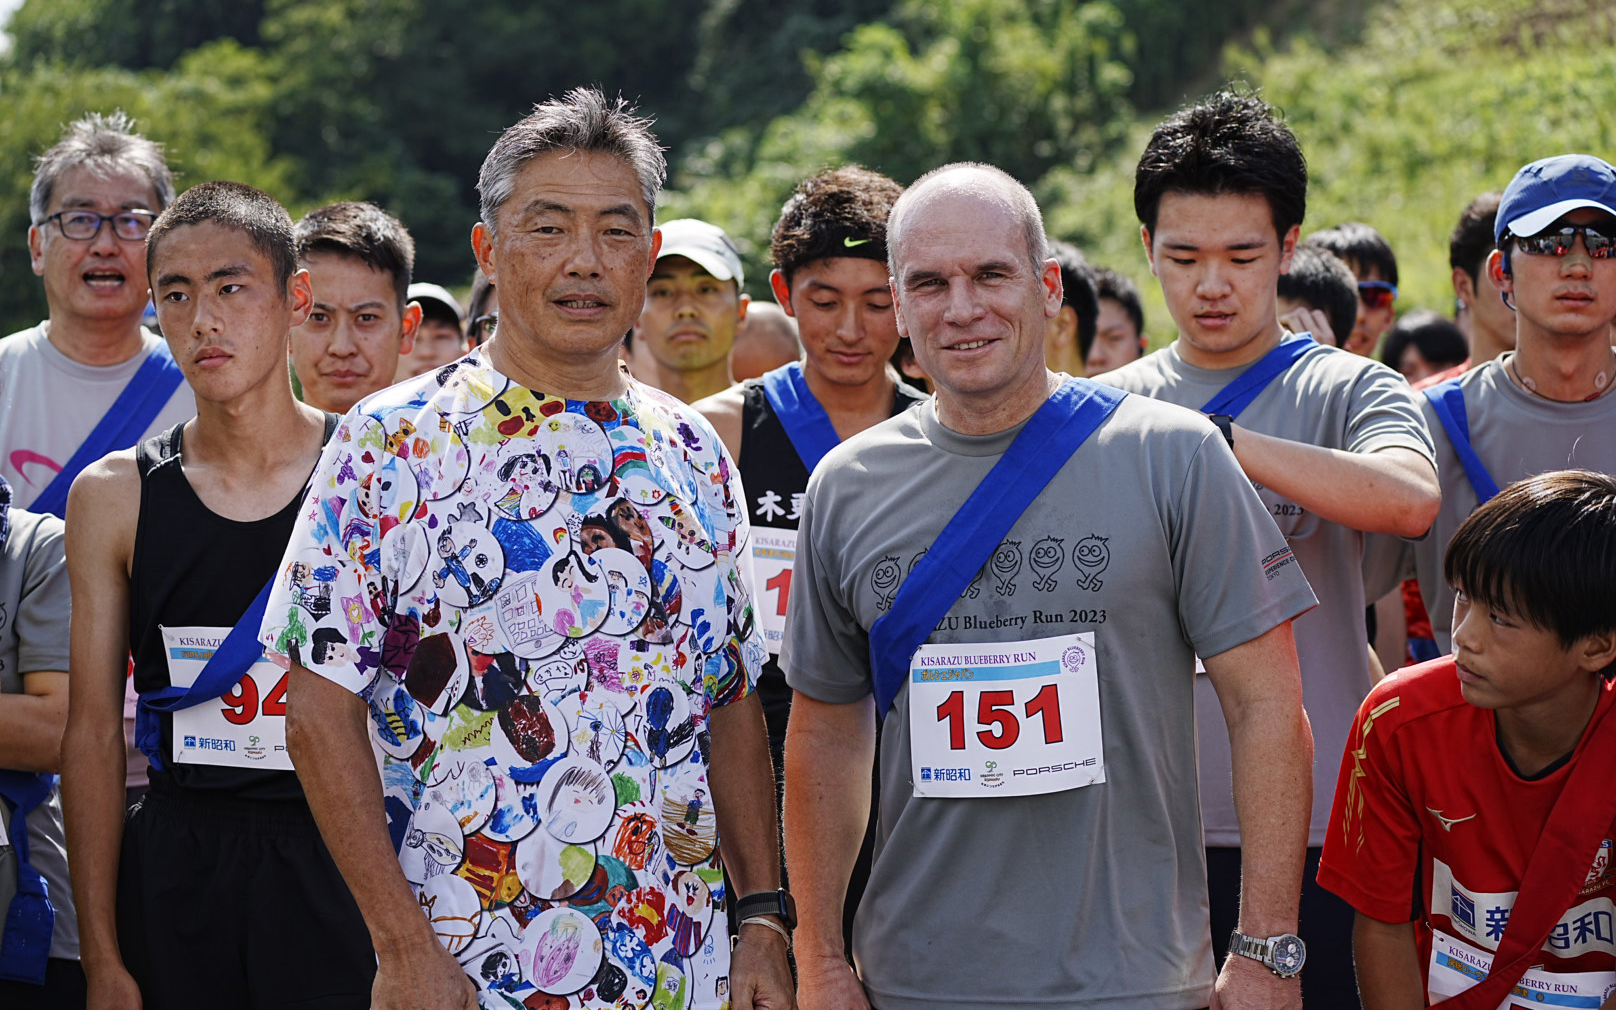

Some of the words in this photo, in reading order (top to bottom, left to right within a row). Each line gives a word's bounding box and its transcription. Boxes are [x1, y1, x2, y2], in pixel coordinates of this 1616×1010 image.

[1261, 546, 1291, 566] PORS
[963, 615, 1027, 630] Blueberry
[1032, 610, 1064, 624] Run
[1069, 609, 1107, 624] 2023
[920, 656, 963, 667] KISARAZU
[964, 654, 1011, 665] BLUEBERRY
[1013, 651, 1037, 663] RUN
[936, 683, 1064, 750] 151
[198, 737, 236, 751] 新昭和
[933, 768, 971, 781] 新昭和
[1012, 757, 1097, 777] PORSCHE
[1554, 984, 1578, 994] RUN
